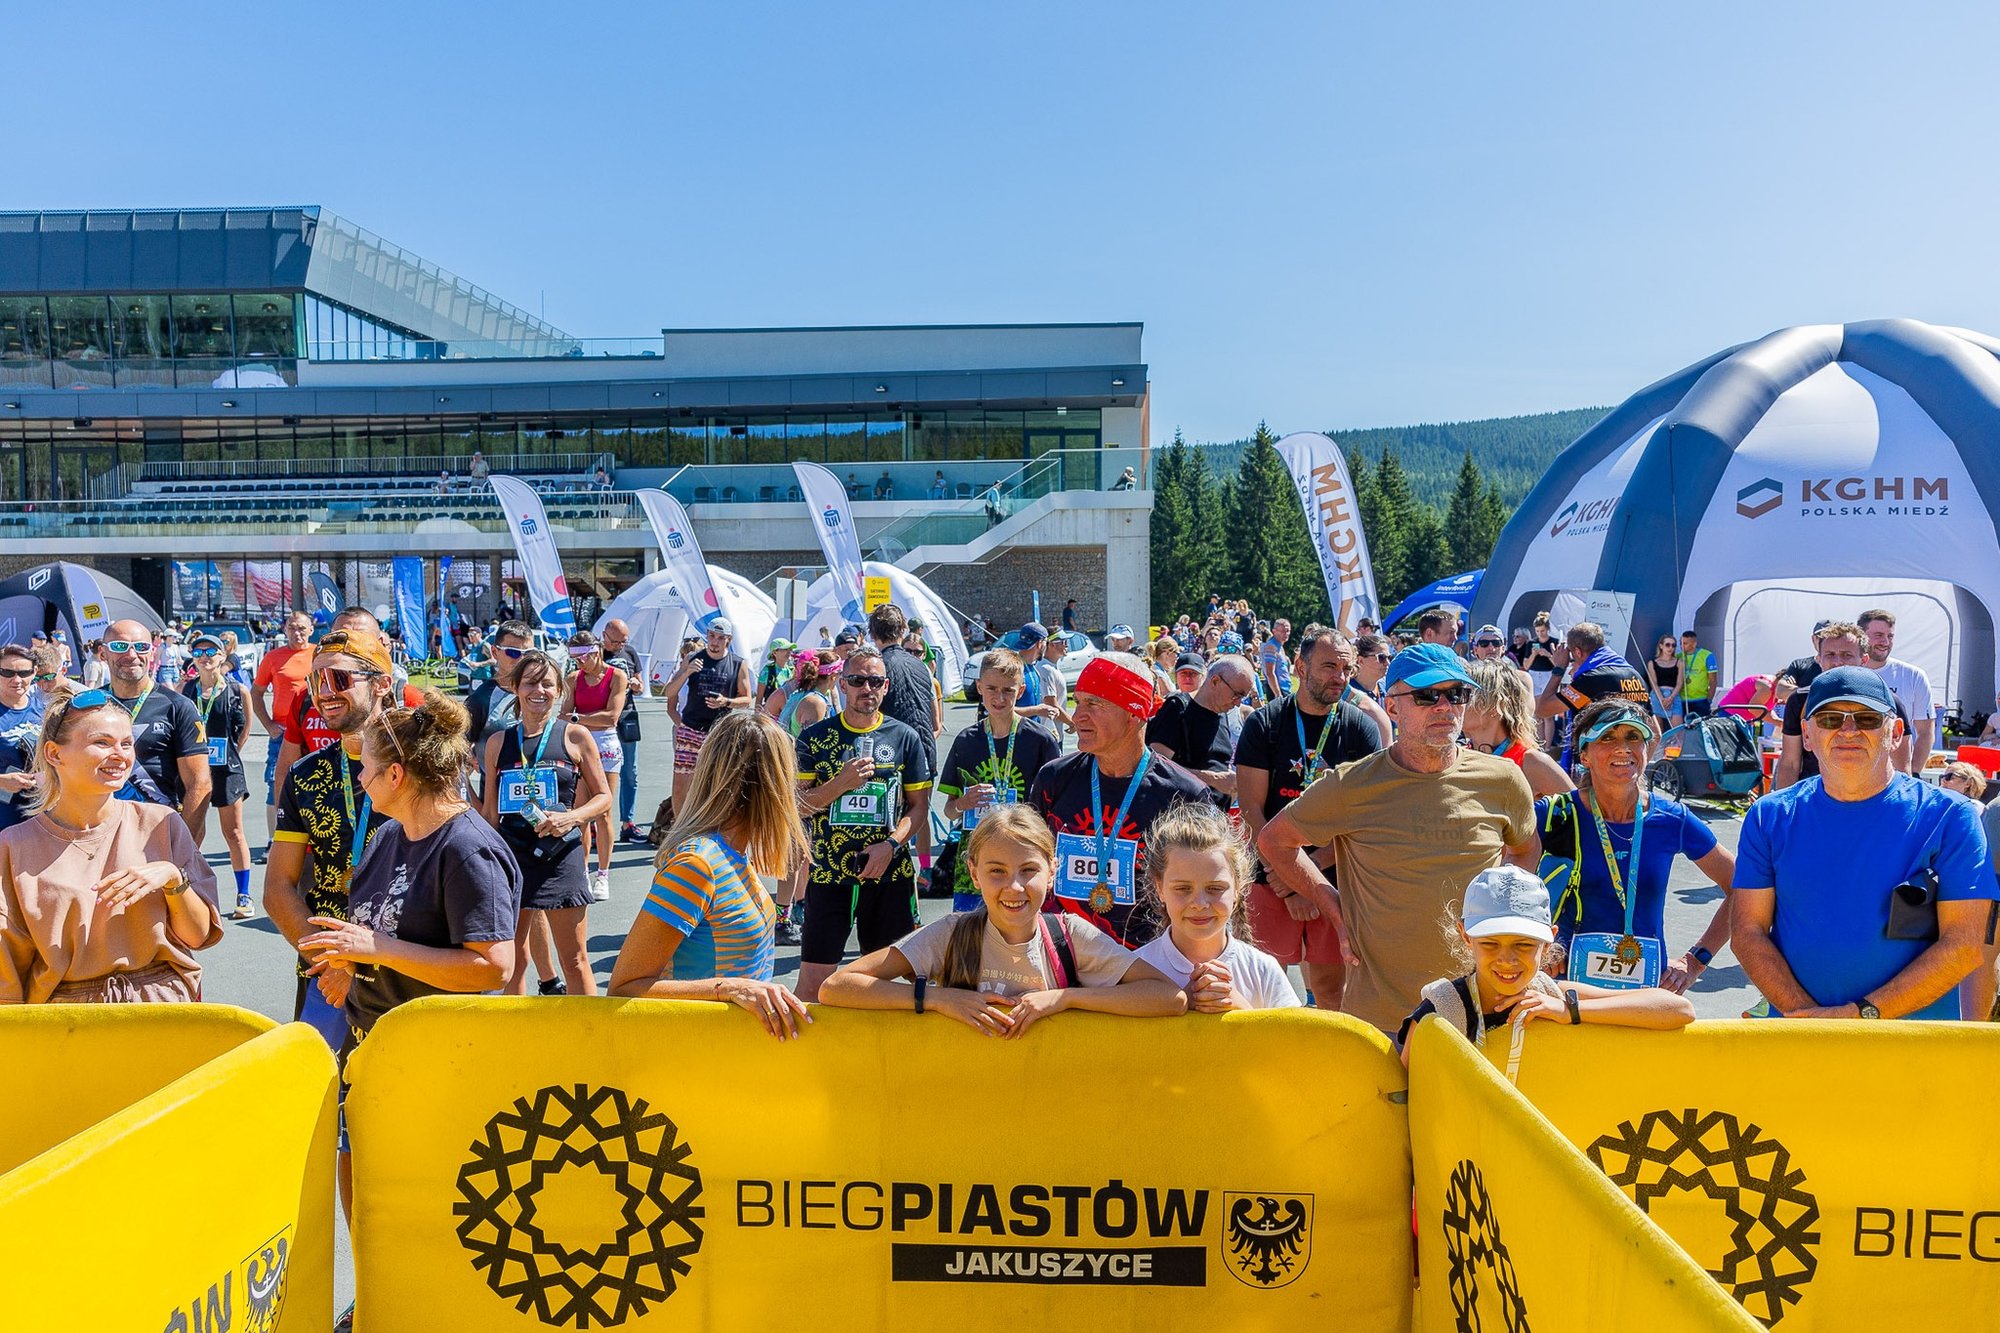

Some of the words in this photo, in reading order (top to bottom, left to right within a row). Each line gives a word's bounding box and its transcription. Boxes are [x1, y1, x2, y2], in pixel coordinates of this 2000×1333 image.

[1802, 477, 1949, 502] KGHM
[1801, 507, 1877, 517] POLSKA
[1888, 505, 1949, 516] MIEDŹ
[1620, 676, 1646, 692] KRÓL
[848, 796, 869, 809] 40
[1596, 956, 1637, 977] 757
[945, 1251, 1153, 1278] JAKUSZYCE
